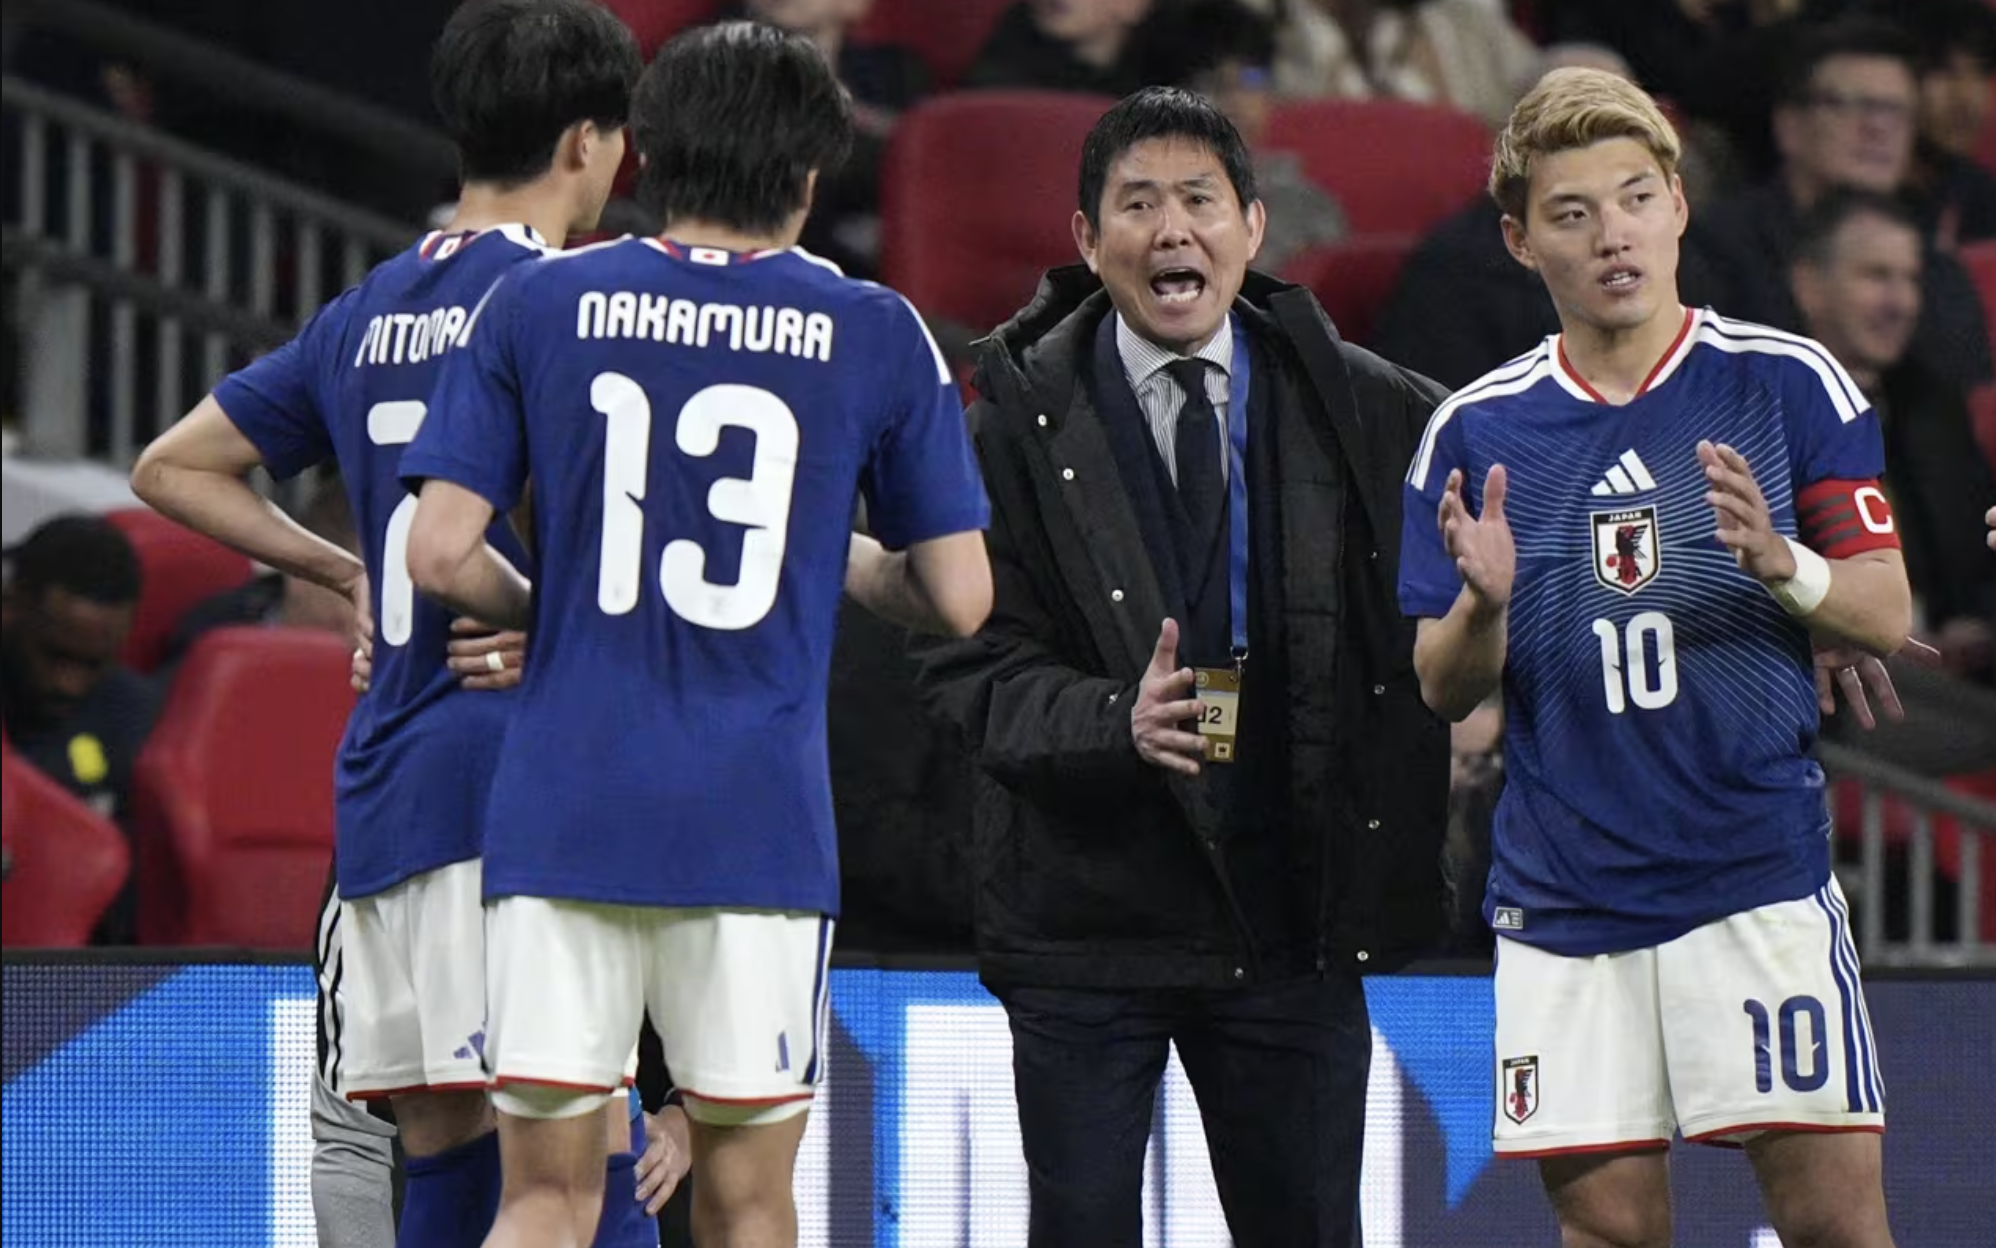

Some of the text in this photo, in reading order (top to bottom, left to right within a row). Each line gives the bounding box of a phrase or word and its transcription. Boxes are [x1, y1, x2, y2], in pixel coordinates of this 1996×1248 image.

[578, 291, 833, 361] NAKAMURA
[591, 372, 799, 630] 13
[1608, 511, 1642, 522] JAPAN
[1854, 486, 1894, 534] C
[1592, 611, 1678, 714] 10
[1743, 995, 1829, 1094] 10
